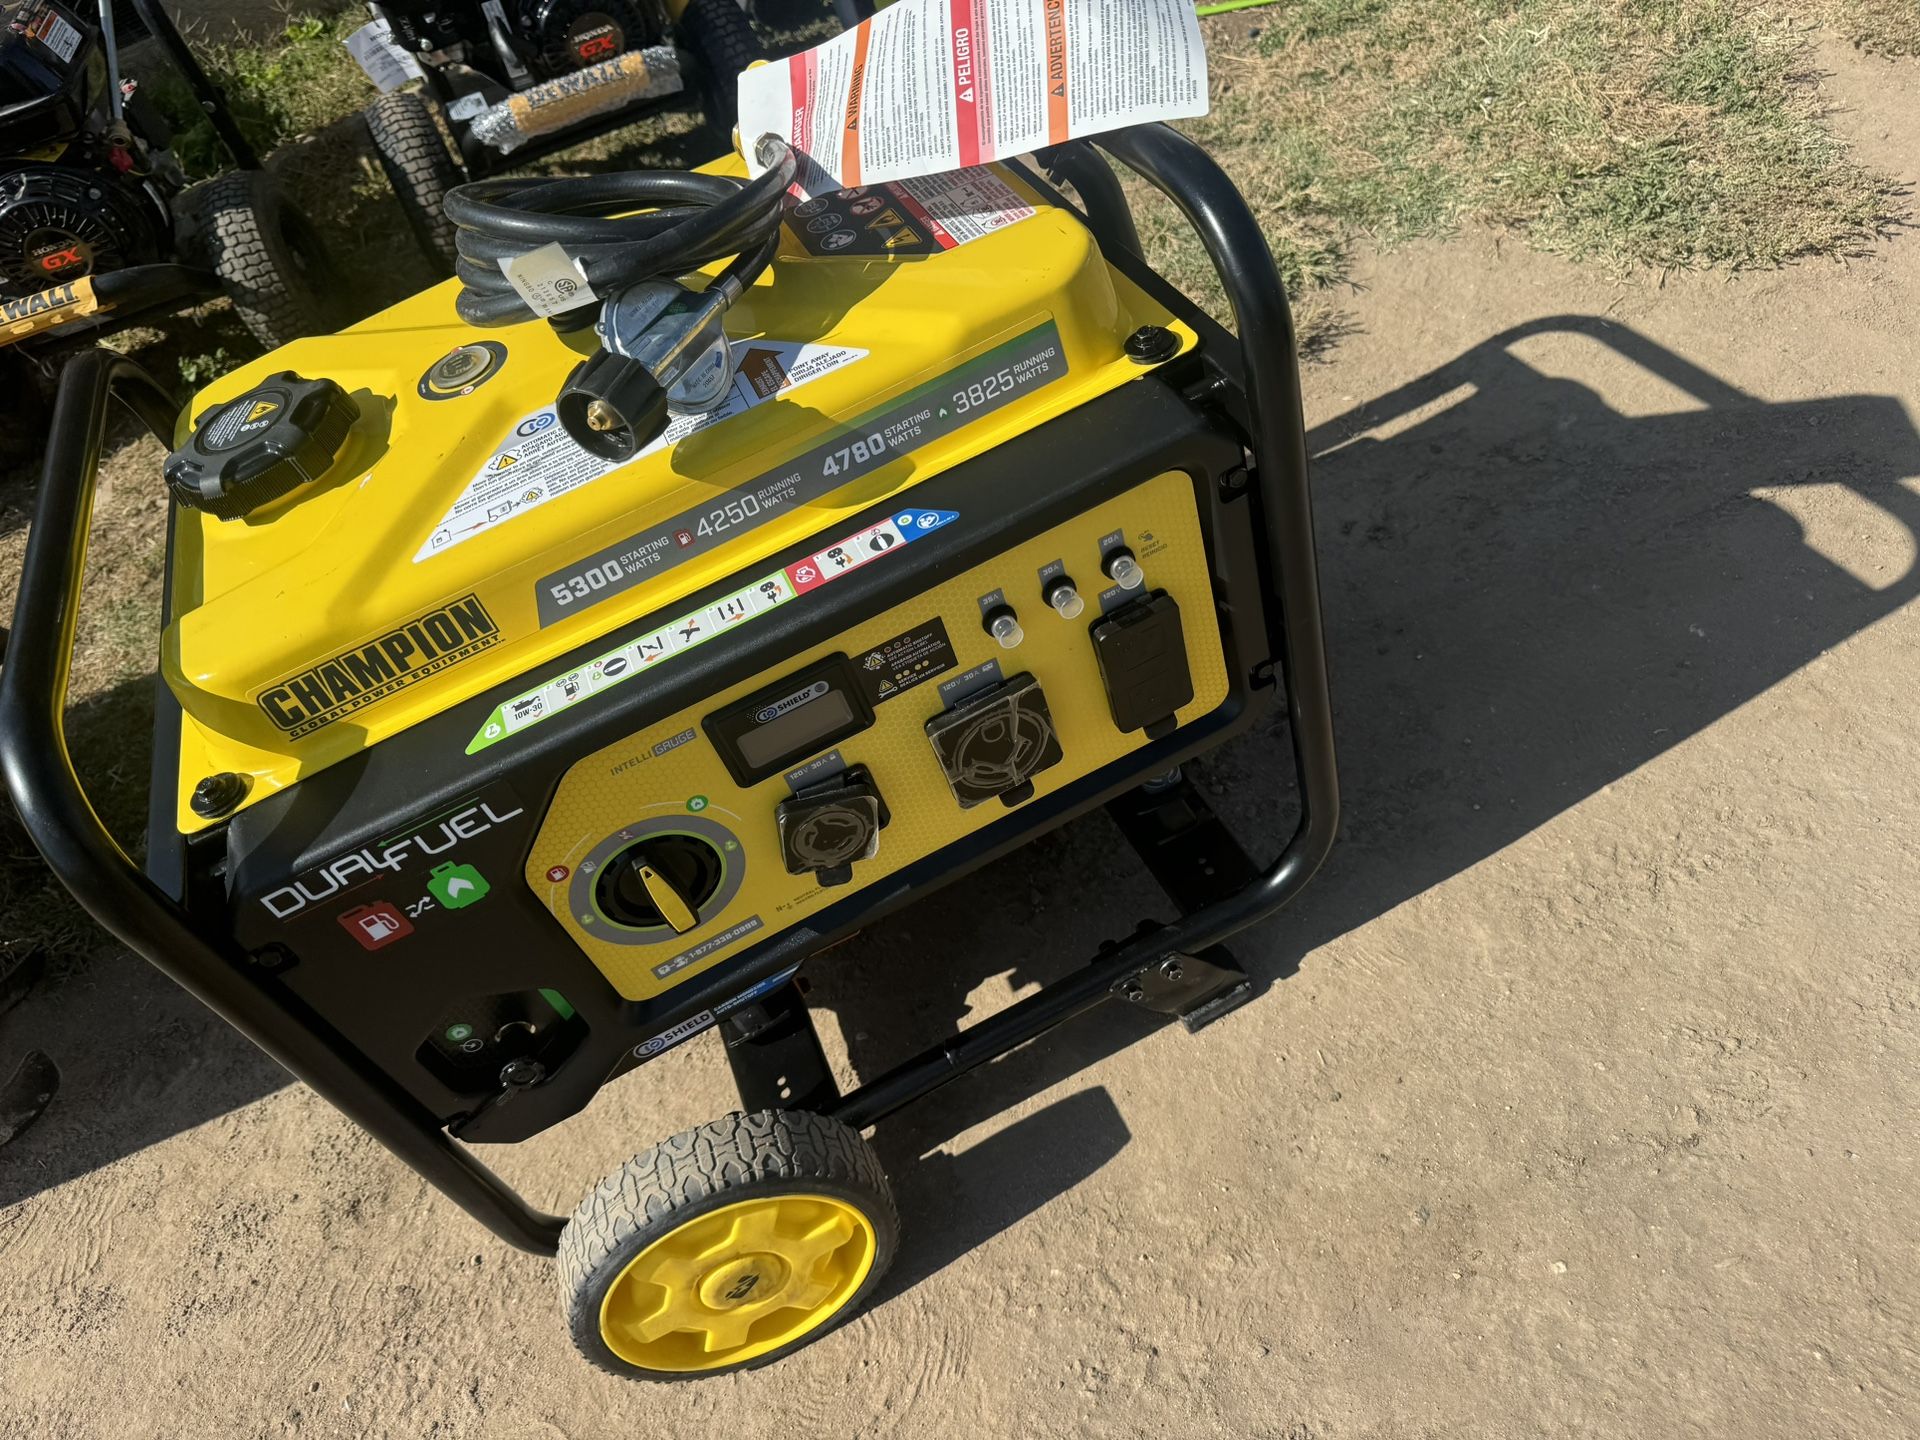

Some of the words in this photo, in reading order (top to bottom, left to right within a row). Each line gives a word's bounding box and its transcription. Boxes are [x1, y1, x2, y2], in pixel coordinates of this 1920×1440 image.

[578, 34, 616, 60] GX
[956, 27, 970, 85] PELIGRO
[847, 64, 862, 117] WARNING
[42, 246, 82, 271] GX
[0, 283, 75, 323] WALT
[788, 360, 809, 373] POINT
[809, 351, 829, 364] AWAY
[791, 364, 813, 378] DIRIJA
[814, 349, 846, 367] ALEJADO
[793, 366, 821, 382] DIRIGER
[822, 358, 839, 369] LOIN
[1016, 362, 1049, 384] WATTS
[952, 369, 1015, 414] 3825
[1013, 347, 1056, 375] RUNNING
[822, 432, 886, 478] 4780
[884, 409, 931, 438] STARTING
[888, 425, 922, 448] WATTS
[697, 494, 761, 537] 4250
[757, 473, 801, 500] RUNNING
[761, 487, 796, 509] WATTS
[550, 559, 624, 606] 5300
[620, 536, 669, 565] STARTING
[625, 552, 661, 575] WATTS
[259, 595, 496, 730] CHAMPION
[289, 707, 349, 739] GLOBAL
[352, 679, 405, 709] POWER
[411, 634, 500, 680] EQUIPMENT
[942, 679, 962, 692] 120V
[513, 701, 543, 720] 10W-30
[777, 690, 811, 713] SHIELD
[664, 1012, 710, 1042] SHIELD
